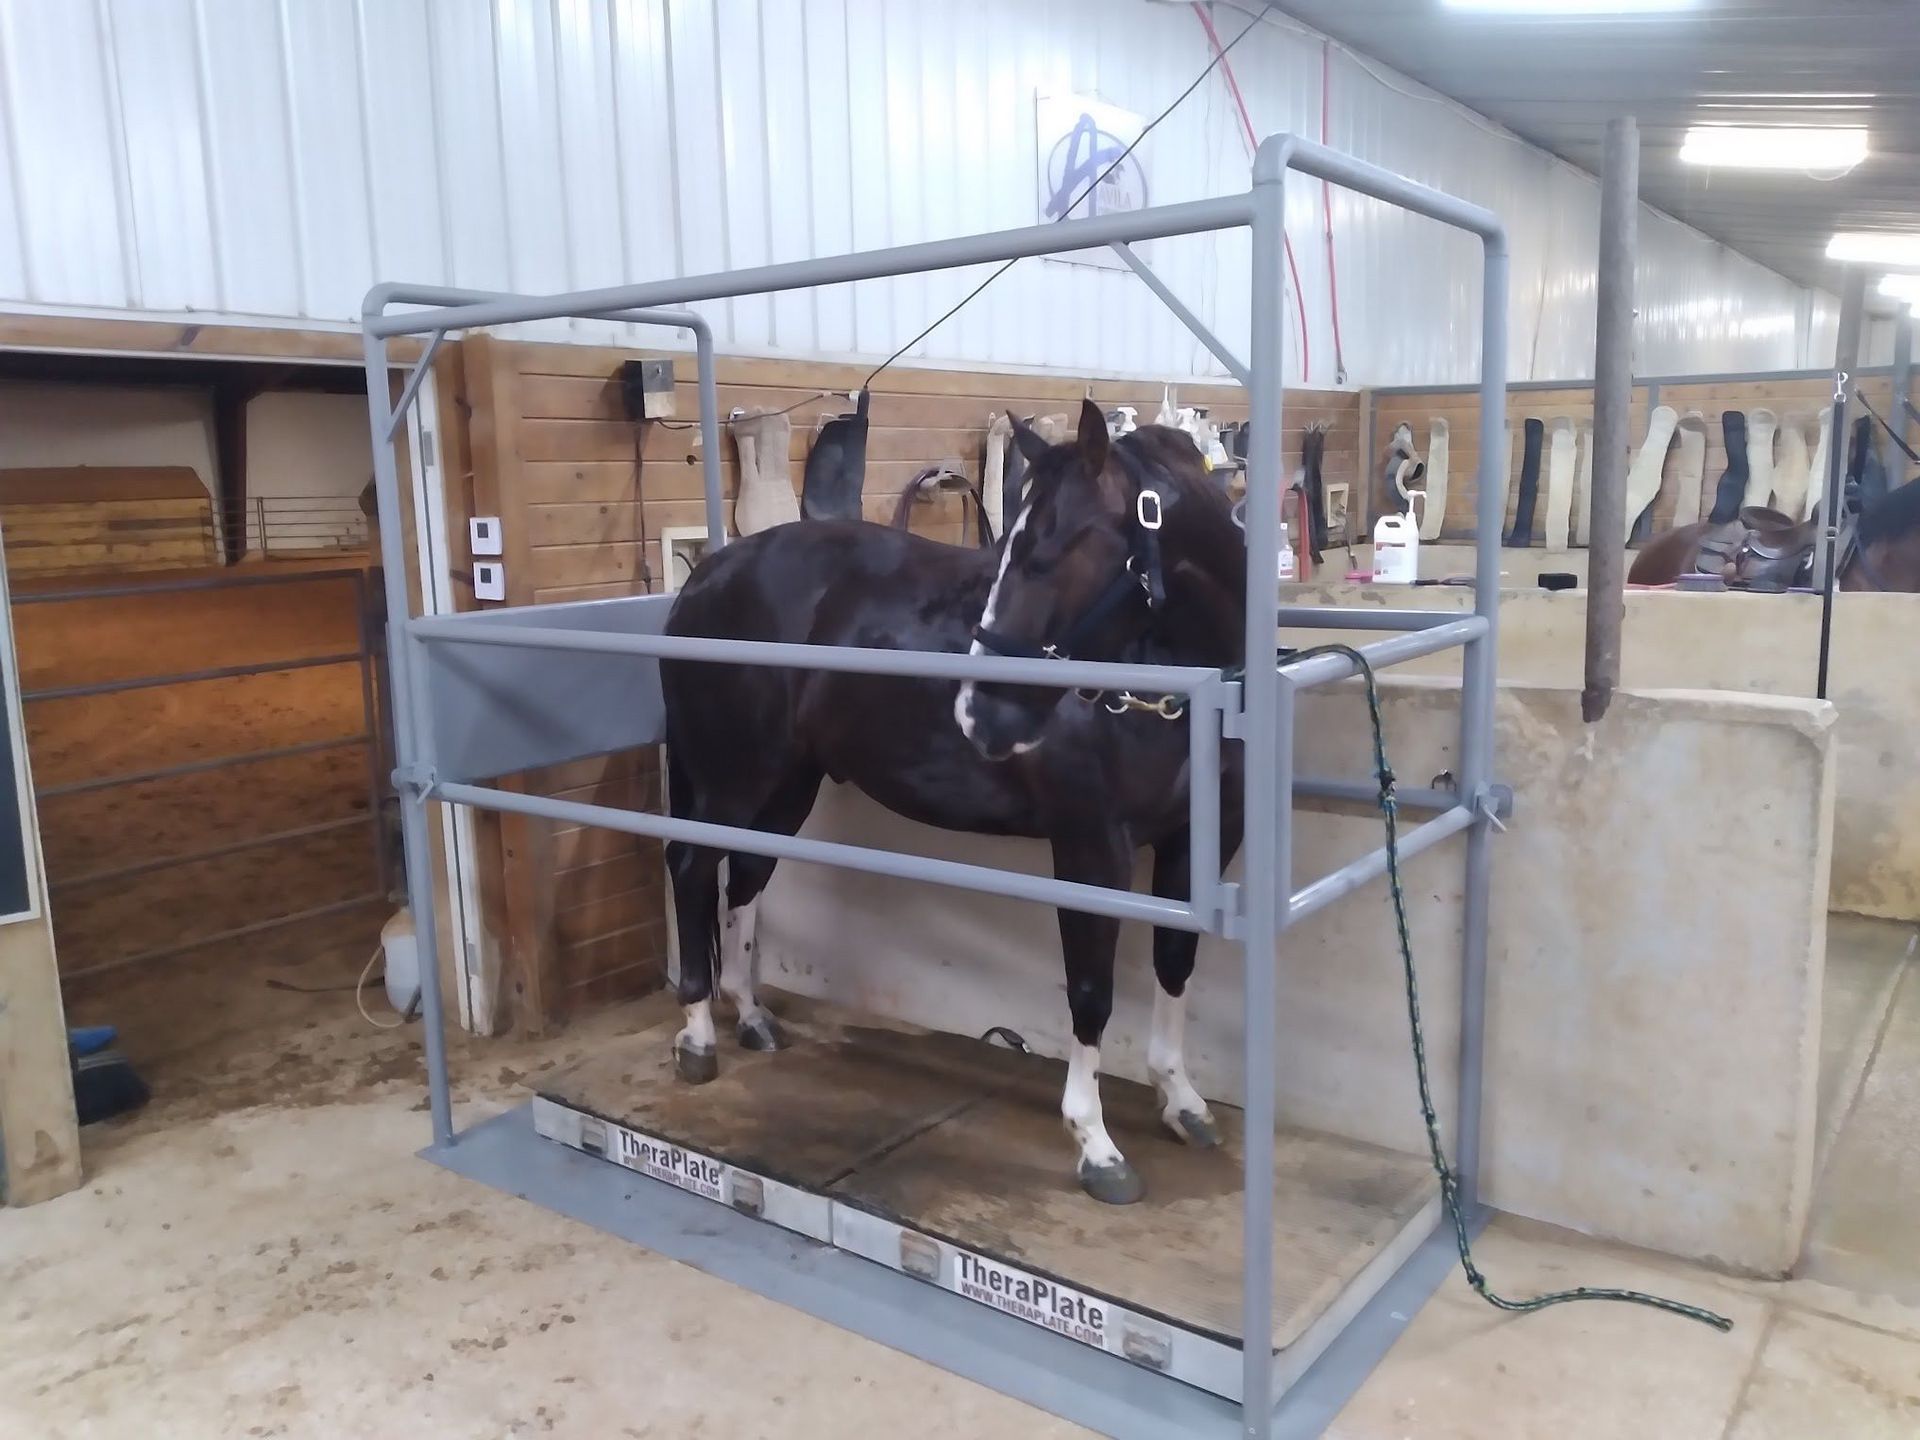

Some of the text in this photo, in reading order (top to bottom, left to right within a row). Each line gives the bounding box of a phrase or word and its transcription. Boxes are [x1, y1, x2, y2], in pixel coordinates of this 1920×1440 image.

[619, 1130, 720, 1185] TheraPlate
[958, 1252, 1103, 1329] TheraPlate
[961, 1281, 1103, 1346] WWW.THERAPLATE.COM
